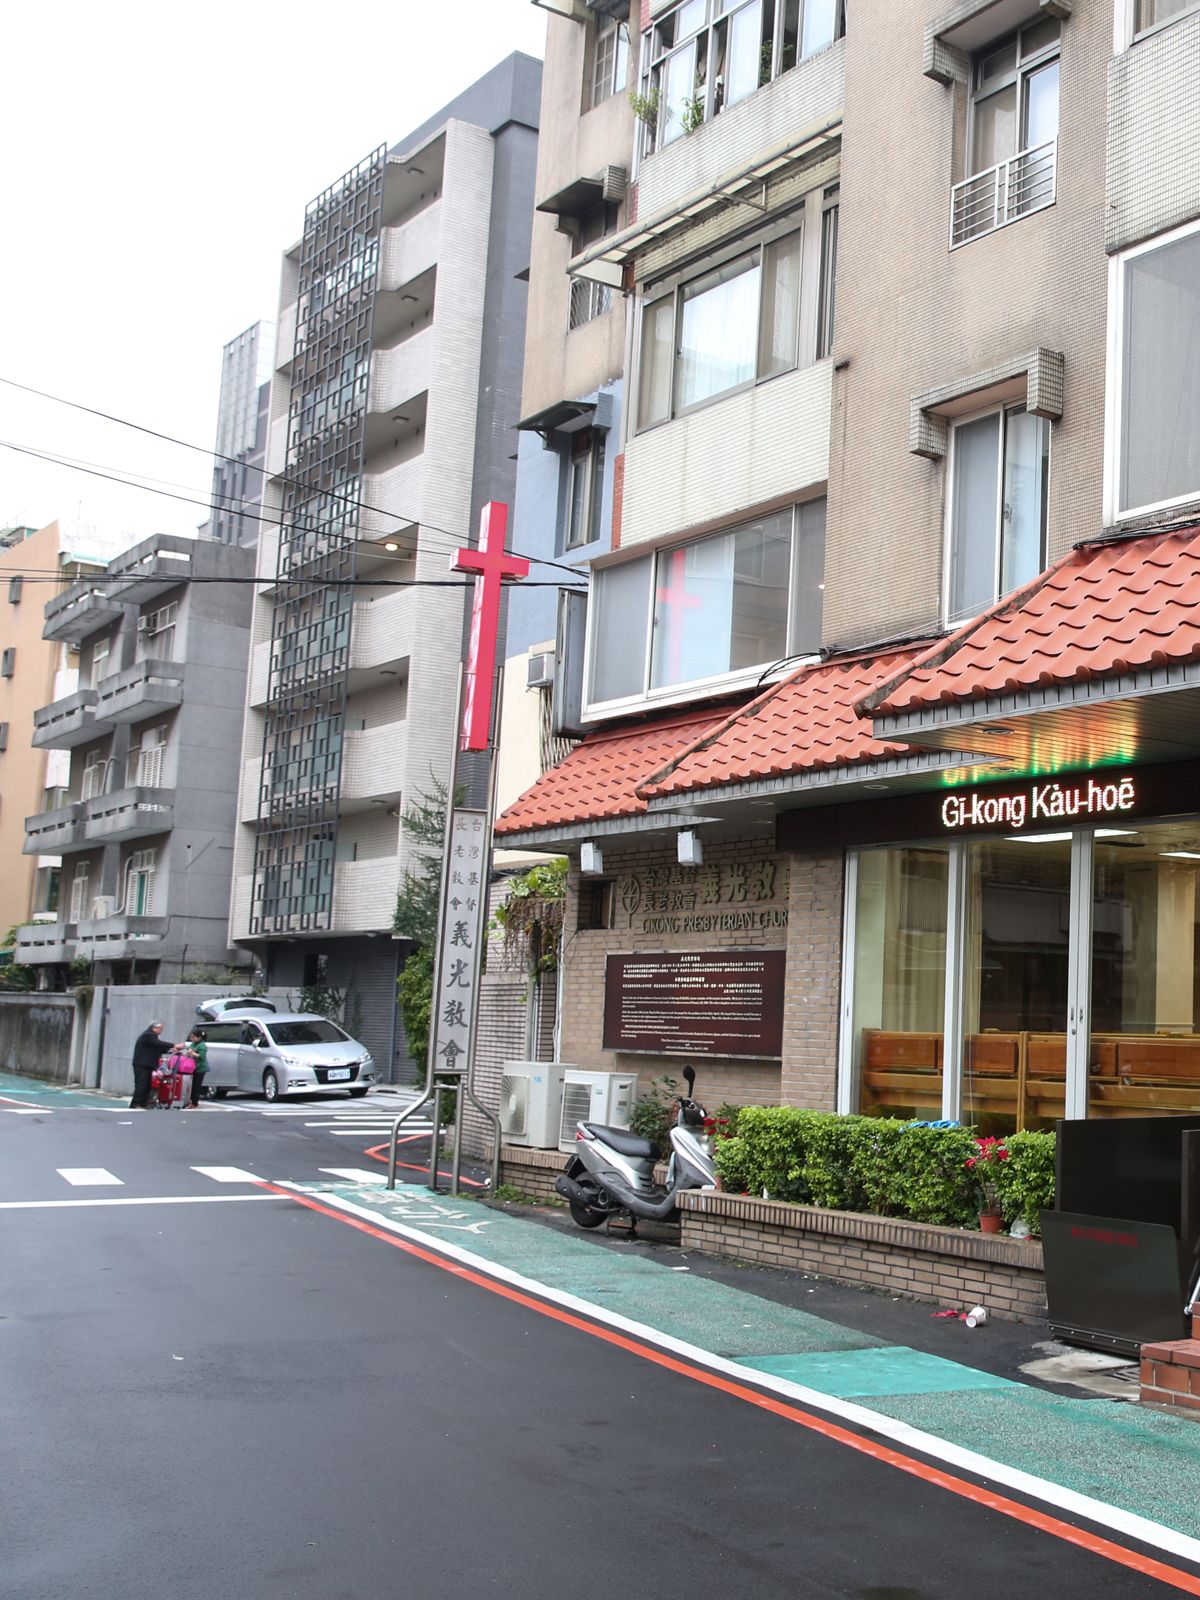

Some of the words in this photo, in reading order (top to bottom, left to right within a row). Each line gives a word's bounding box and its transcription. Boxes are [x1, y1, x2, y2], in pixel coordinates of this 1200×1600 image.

[683, 911, 756, 932] PRESBYTERIAN
[438, 920, 473, 1069] 義光教會
